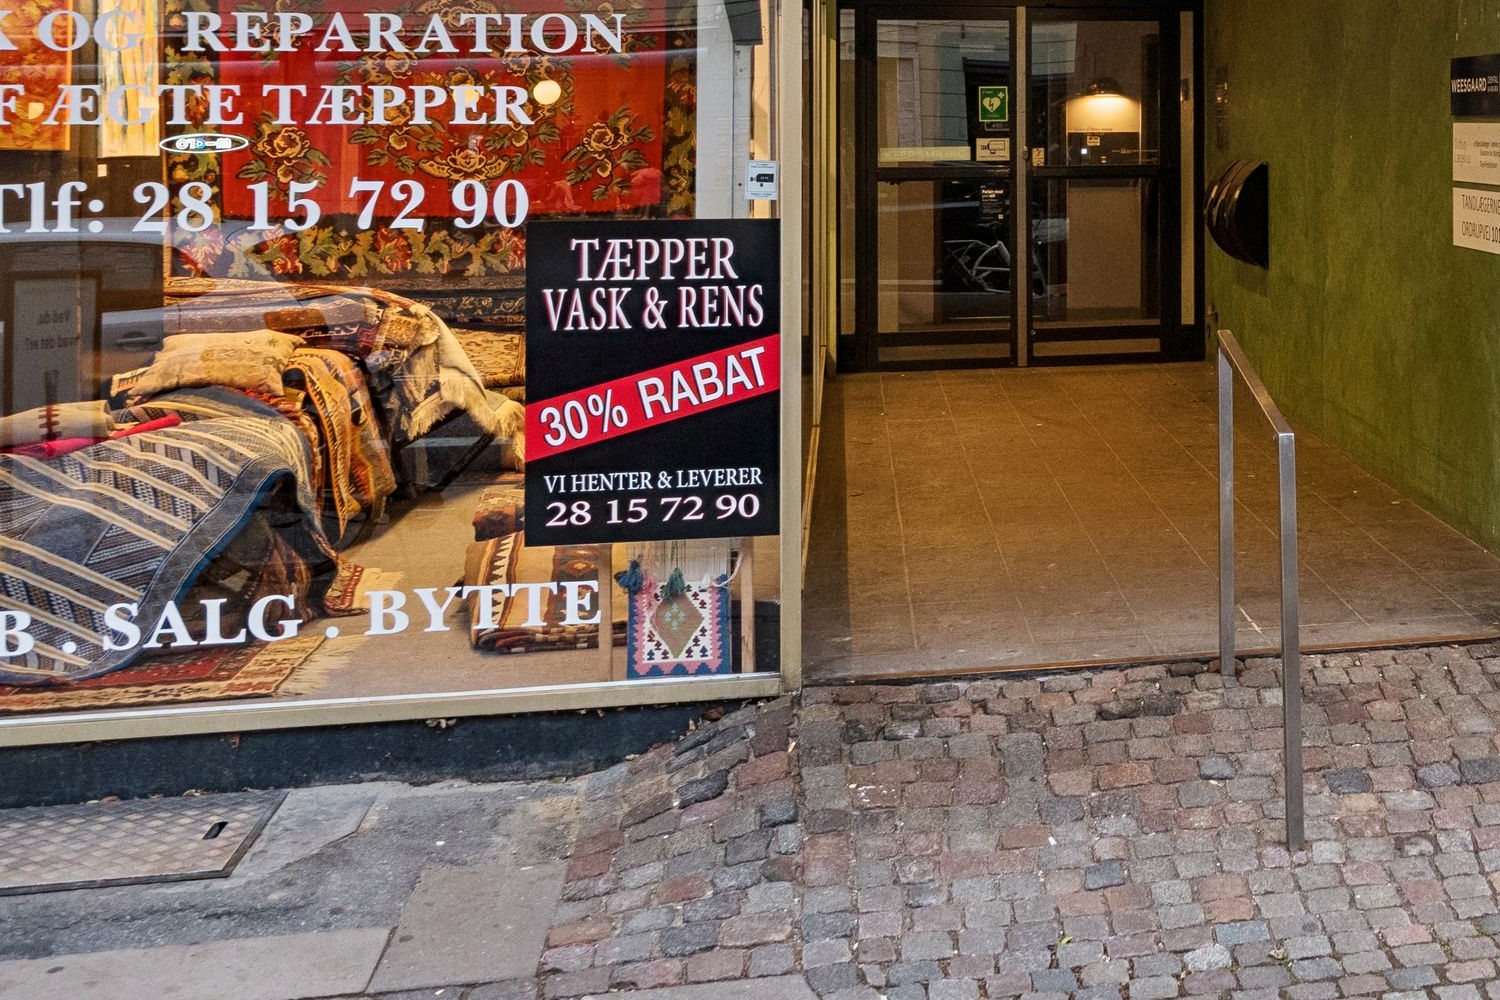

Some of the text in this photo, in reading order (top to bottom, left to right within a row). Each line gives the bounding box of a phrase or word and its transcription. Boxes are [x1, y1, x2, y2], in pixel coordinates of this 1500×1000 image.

[38, 9, 143, 52] OG
[180, 10, 625, 55] REPARATION
[42, 83, 244, 127] ÆGTE
[263, 84, 535, 127] TÆPPER
[1450, 77, 1487, 93] WEESGAARD
[132, 180, 216, 236] 28
[247, 180, 321, 232] 15
[348, 179, 427, 233] 72
[451, 178, 530, 230] 90
[1462, 194, 1500, 216] TANDLÆGERNE
[568, 236, 740, 284] TÆPPER
[541, 283, 766, 334] VASK & RENS
[538, 346, 770, 450] 30% RABAT
[543, 466, 764, 495] VI HENTER & LEVERER
[545, 494, 761, 528] 28 15 72 90
[102, 593, 304, 652] SALG
[365, 578, 603, 638] BYTTE
